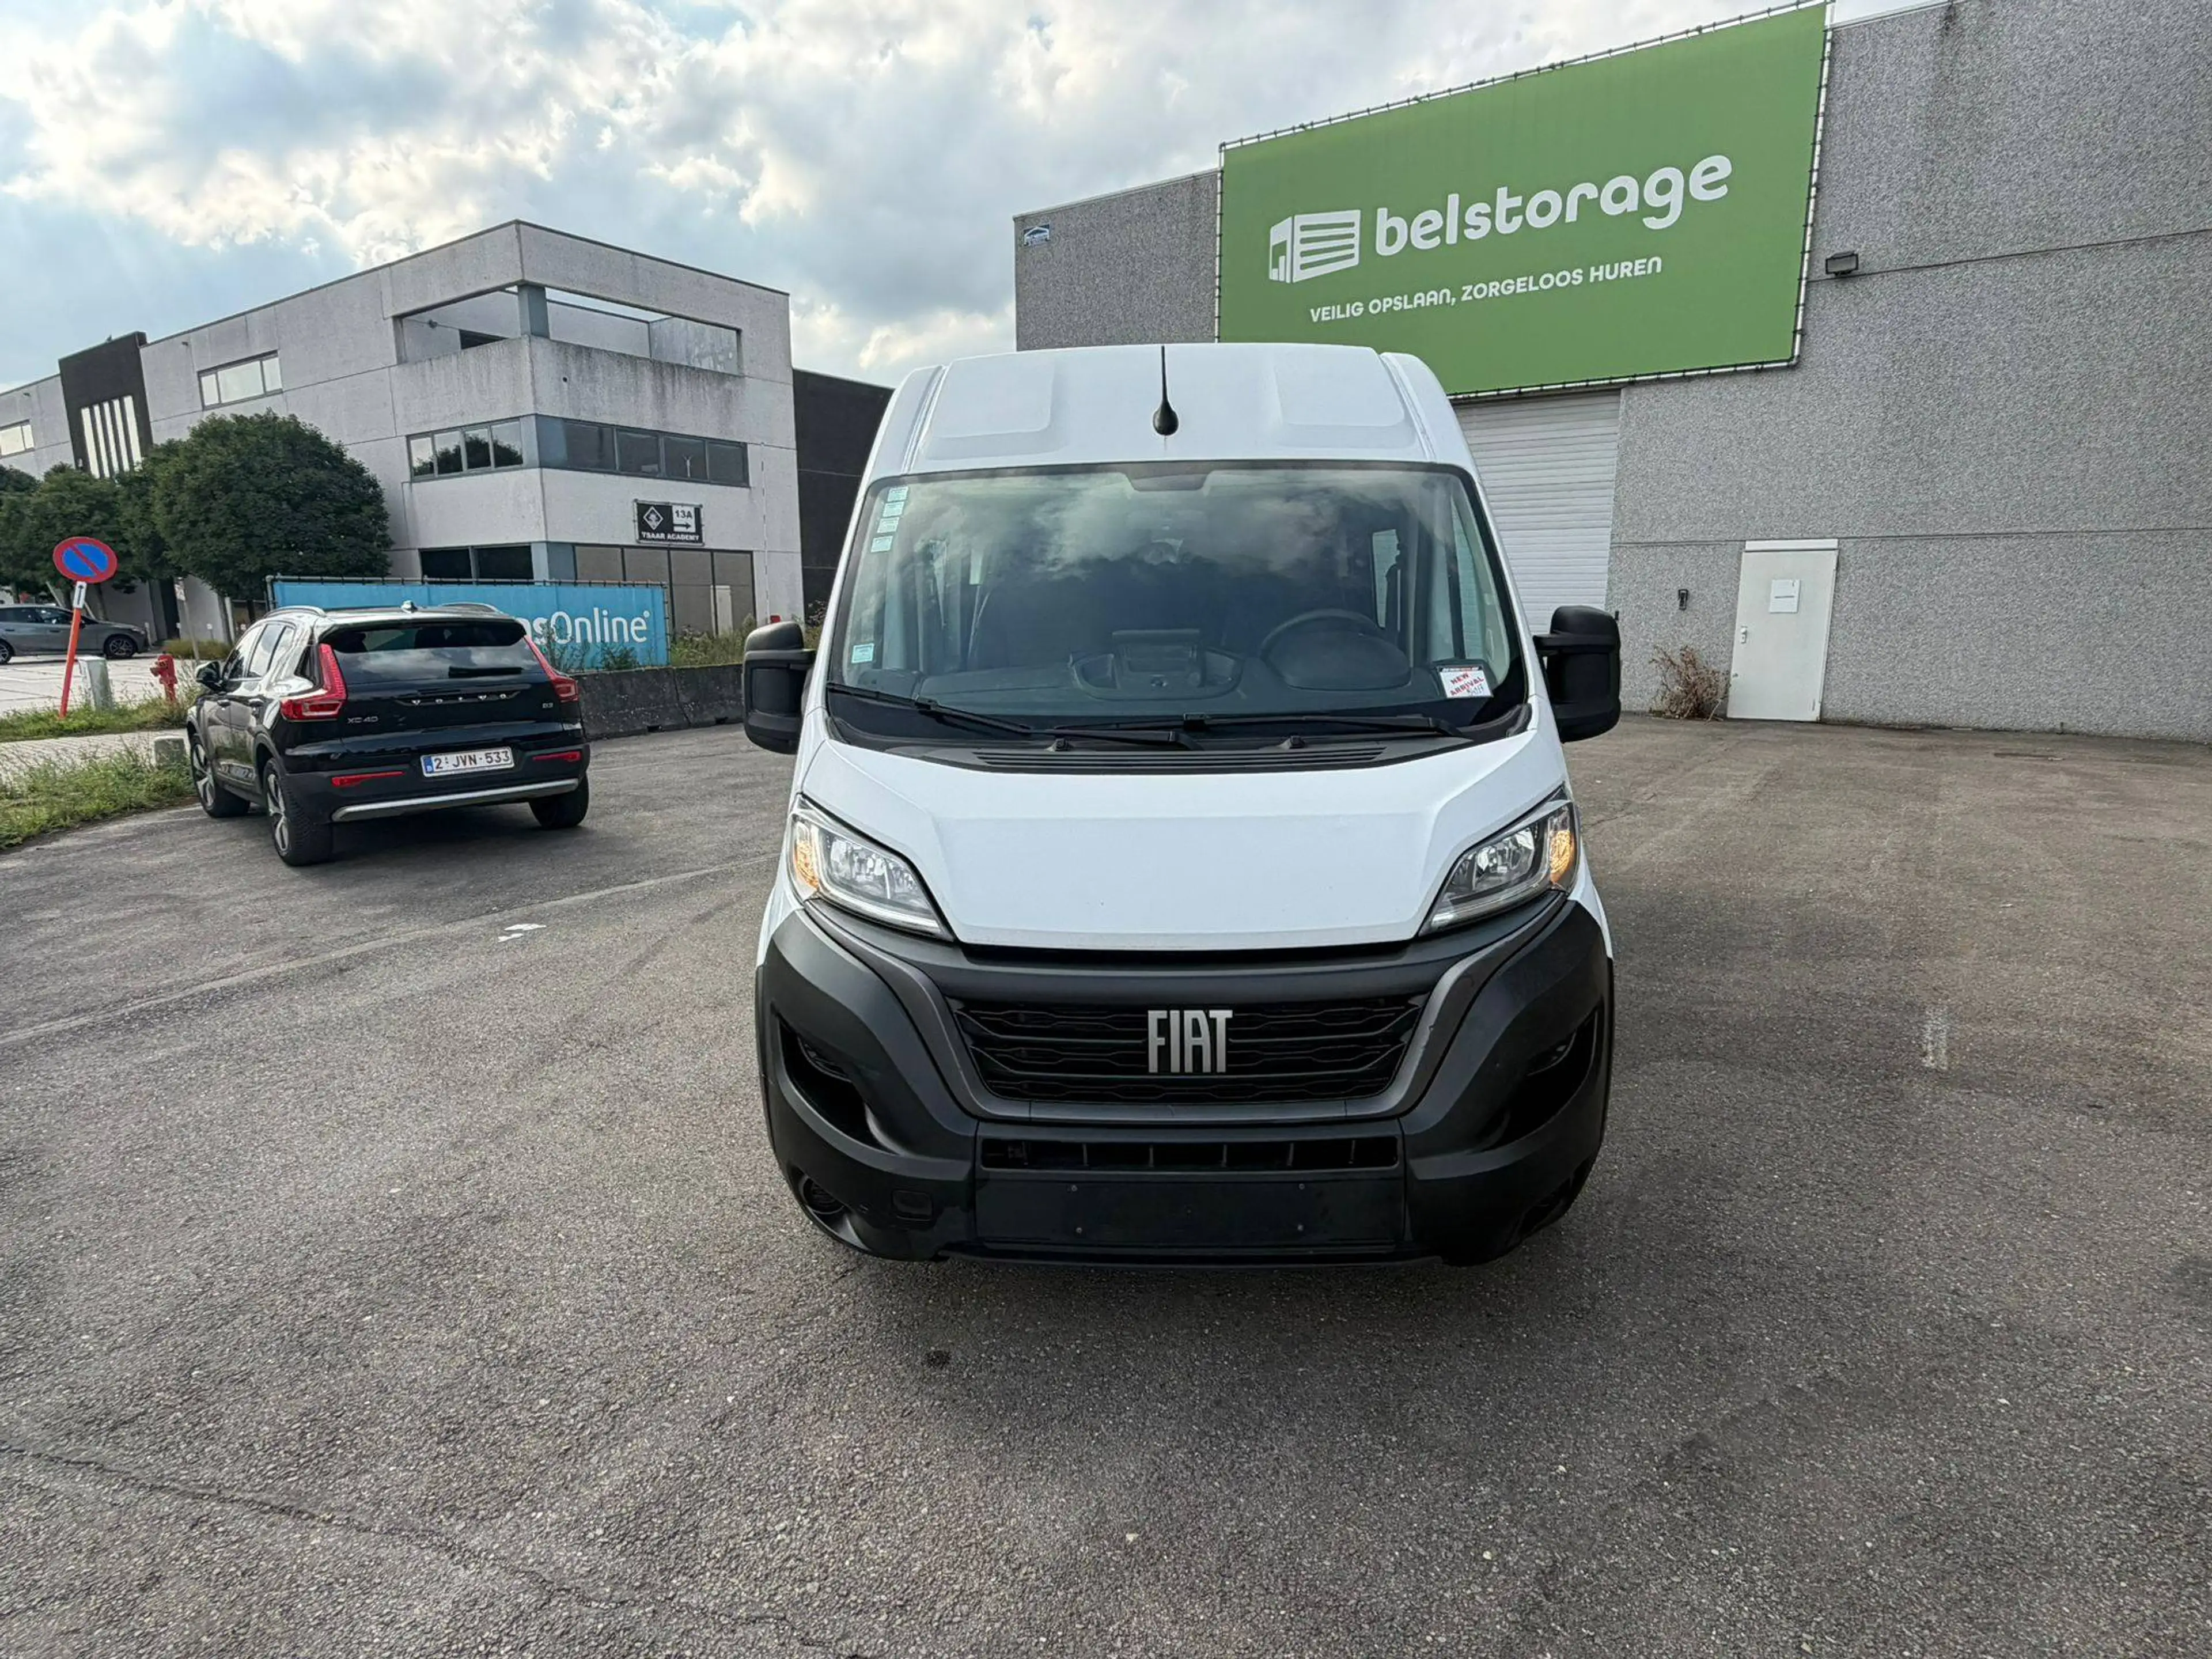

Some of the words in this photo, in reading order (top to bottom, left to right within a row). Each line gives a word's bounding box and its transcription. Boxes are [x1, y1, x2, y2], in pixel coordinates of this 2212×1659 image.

[1376, 155, 1732, 256] belstorage
[1310, 302, 1364, 322] VEILIG
[1368, 289, 1456, 314] OPSLAAN,
[1461, 268, 1584, 301] ZORGELOOS
[1589, 256, 1662, 283] HUREN
[642, 531, 665, 540] TSAAR
[667, 533, 700, 541] ACADEMY
[675, 509, 692, 519] 13A
[1147, 1010, 1233, 1073] FIAT
